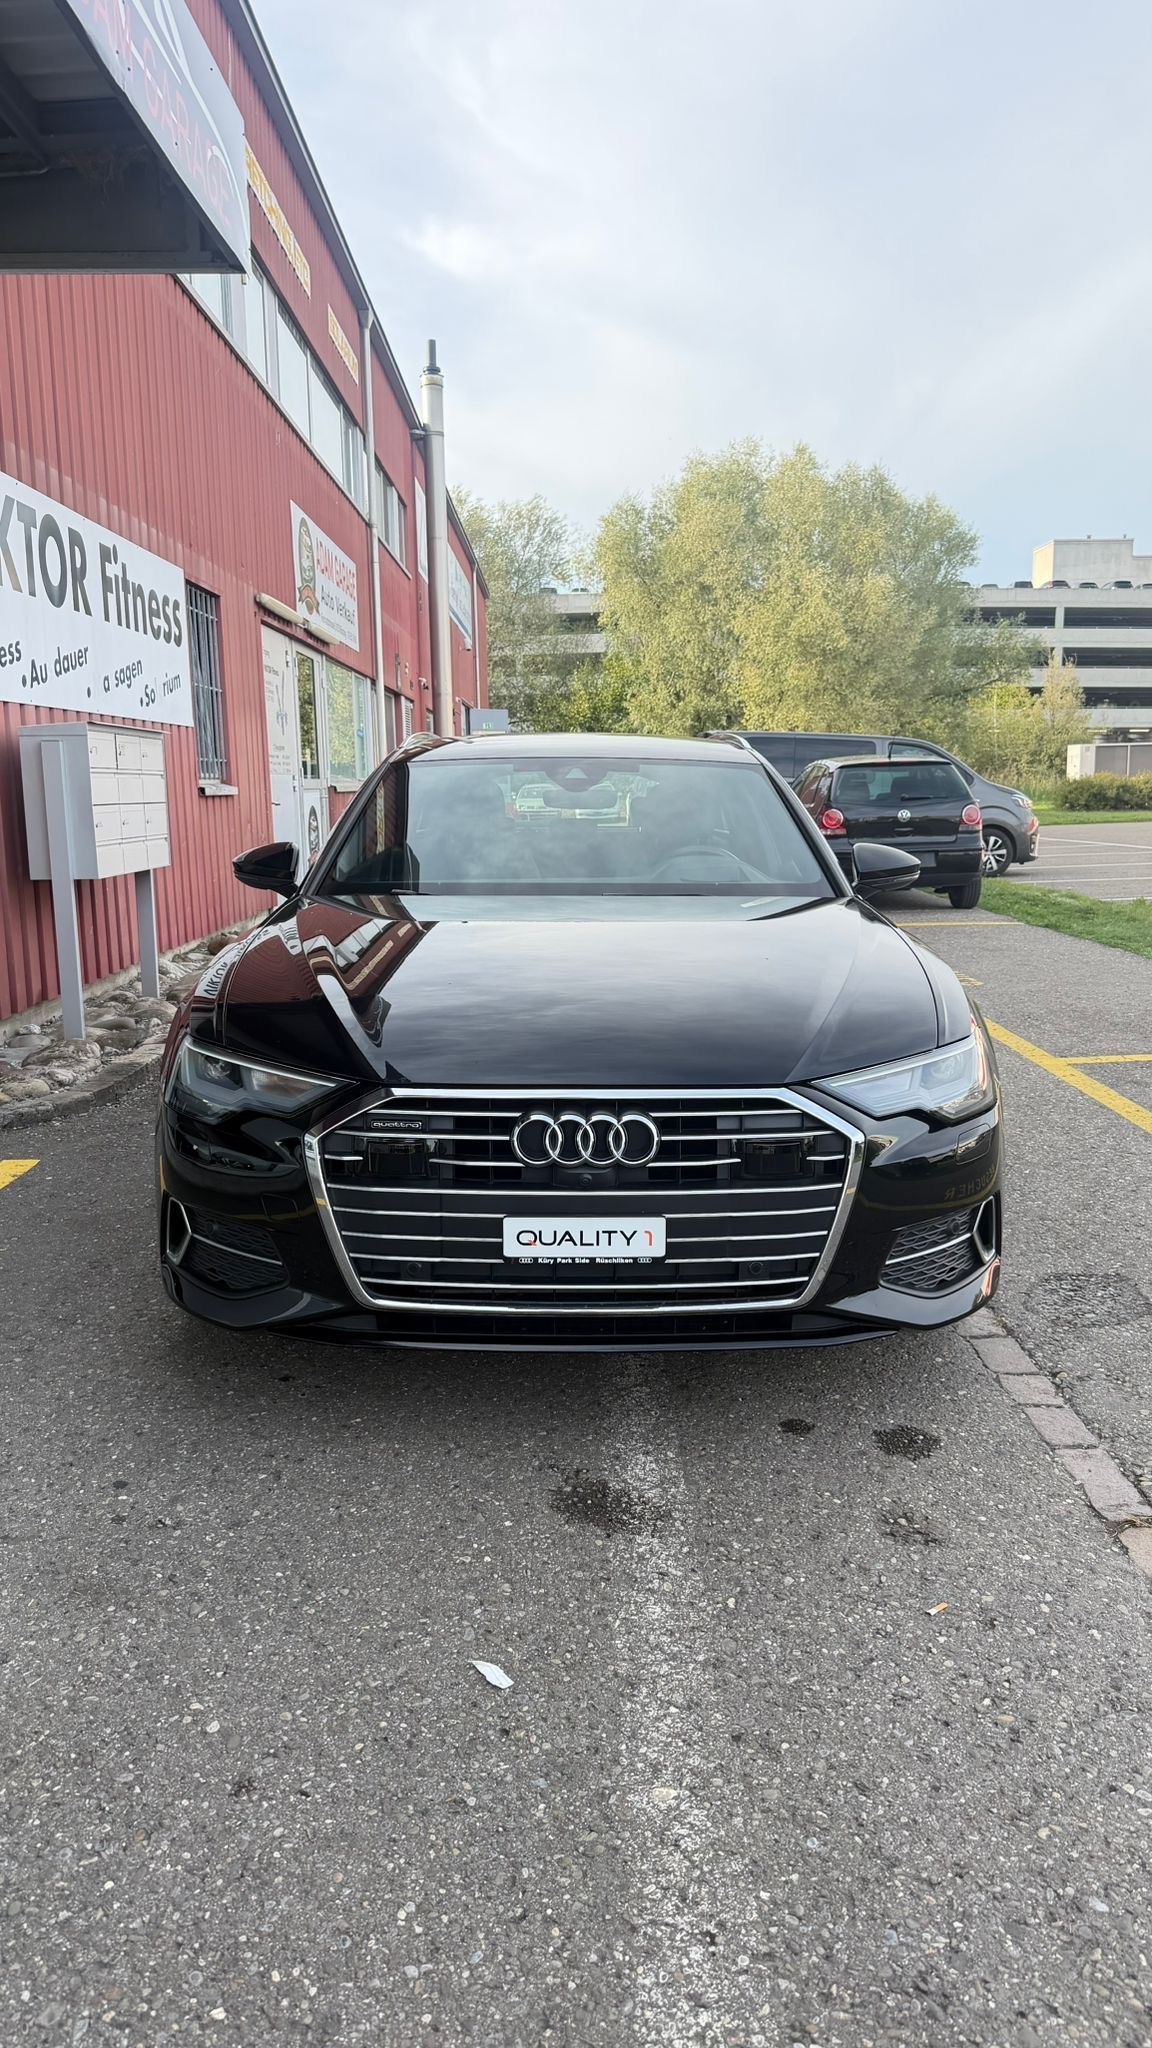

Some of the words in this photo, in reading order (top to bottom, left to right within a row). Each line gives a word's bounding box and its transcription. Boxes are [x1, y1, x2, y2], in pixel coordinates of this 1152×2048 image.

[143, 36, 233, 229] GARAGE
[99, 542, 182, 648] Fitness
[373, 1121, 420, 1129] quattro
[516, 1230, 638, 1247] QUALITY
[644, 1230, 653, 1247] 1
